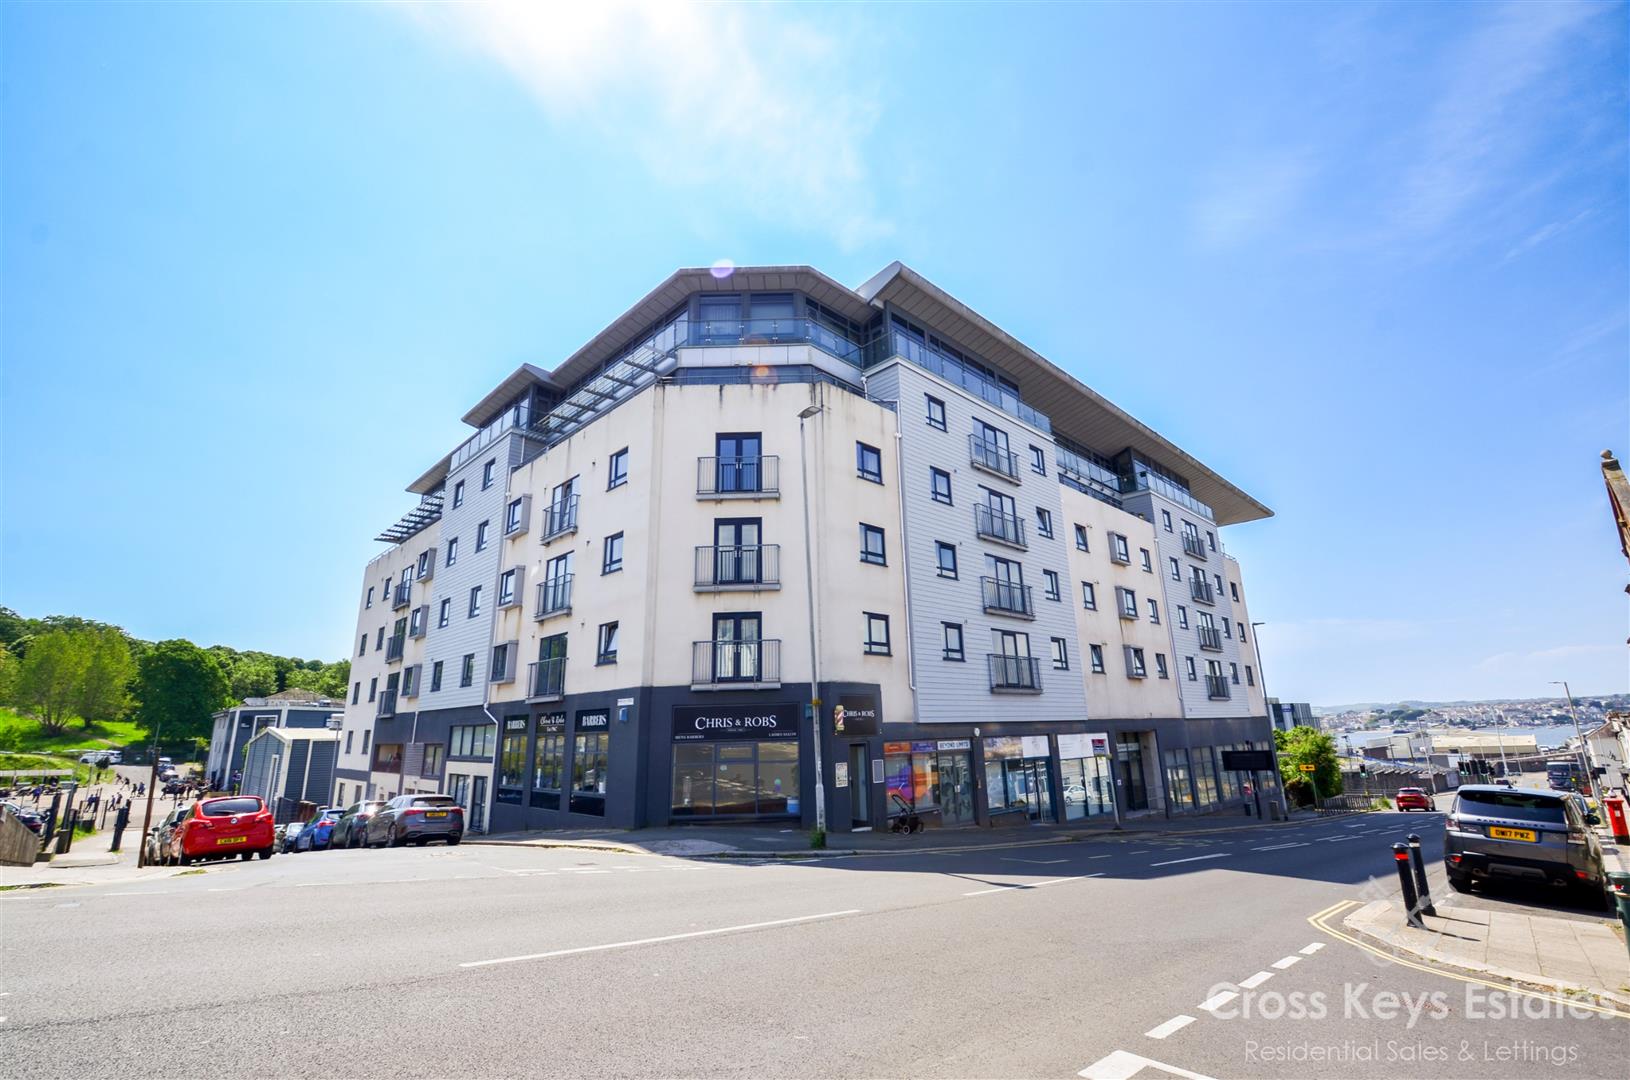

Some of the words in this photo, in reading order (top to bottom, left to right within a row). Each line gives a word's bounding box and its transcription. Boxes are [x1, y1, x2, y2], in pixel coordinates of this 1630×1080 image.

[507, 720, 526, 730] BARBERS
[581, 715, 608, 727] BARBERS
[695, 717, 733, 730] CHRIS
[744, 715, 777, 728] ROBS
